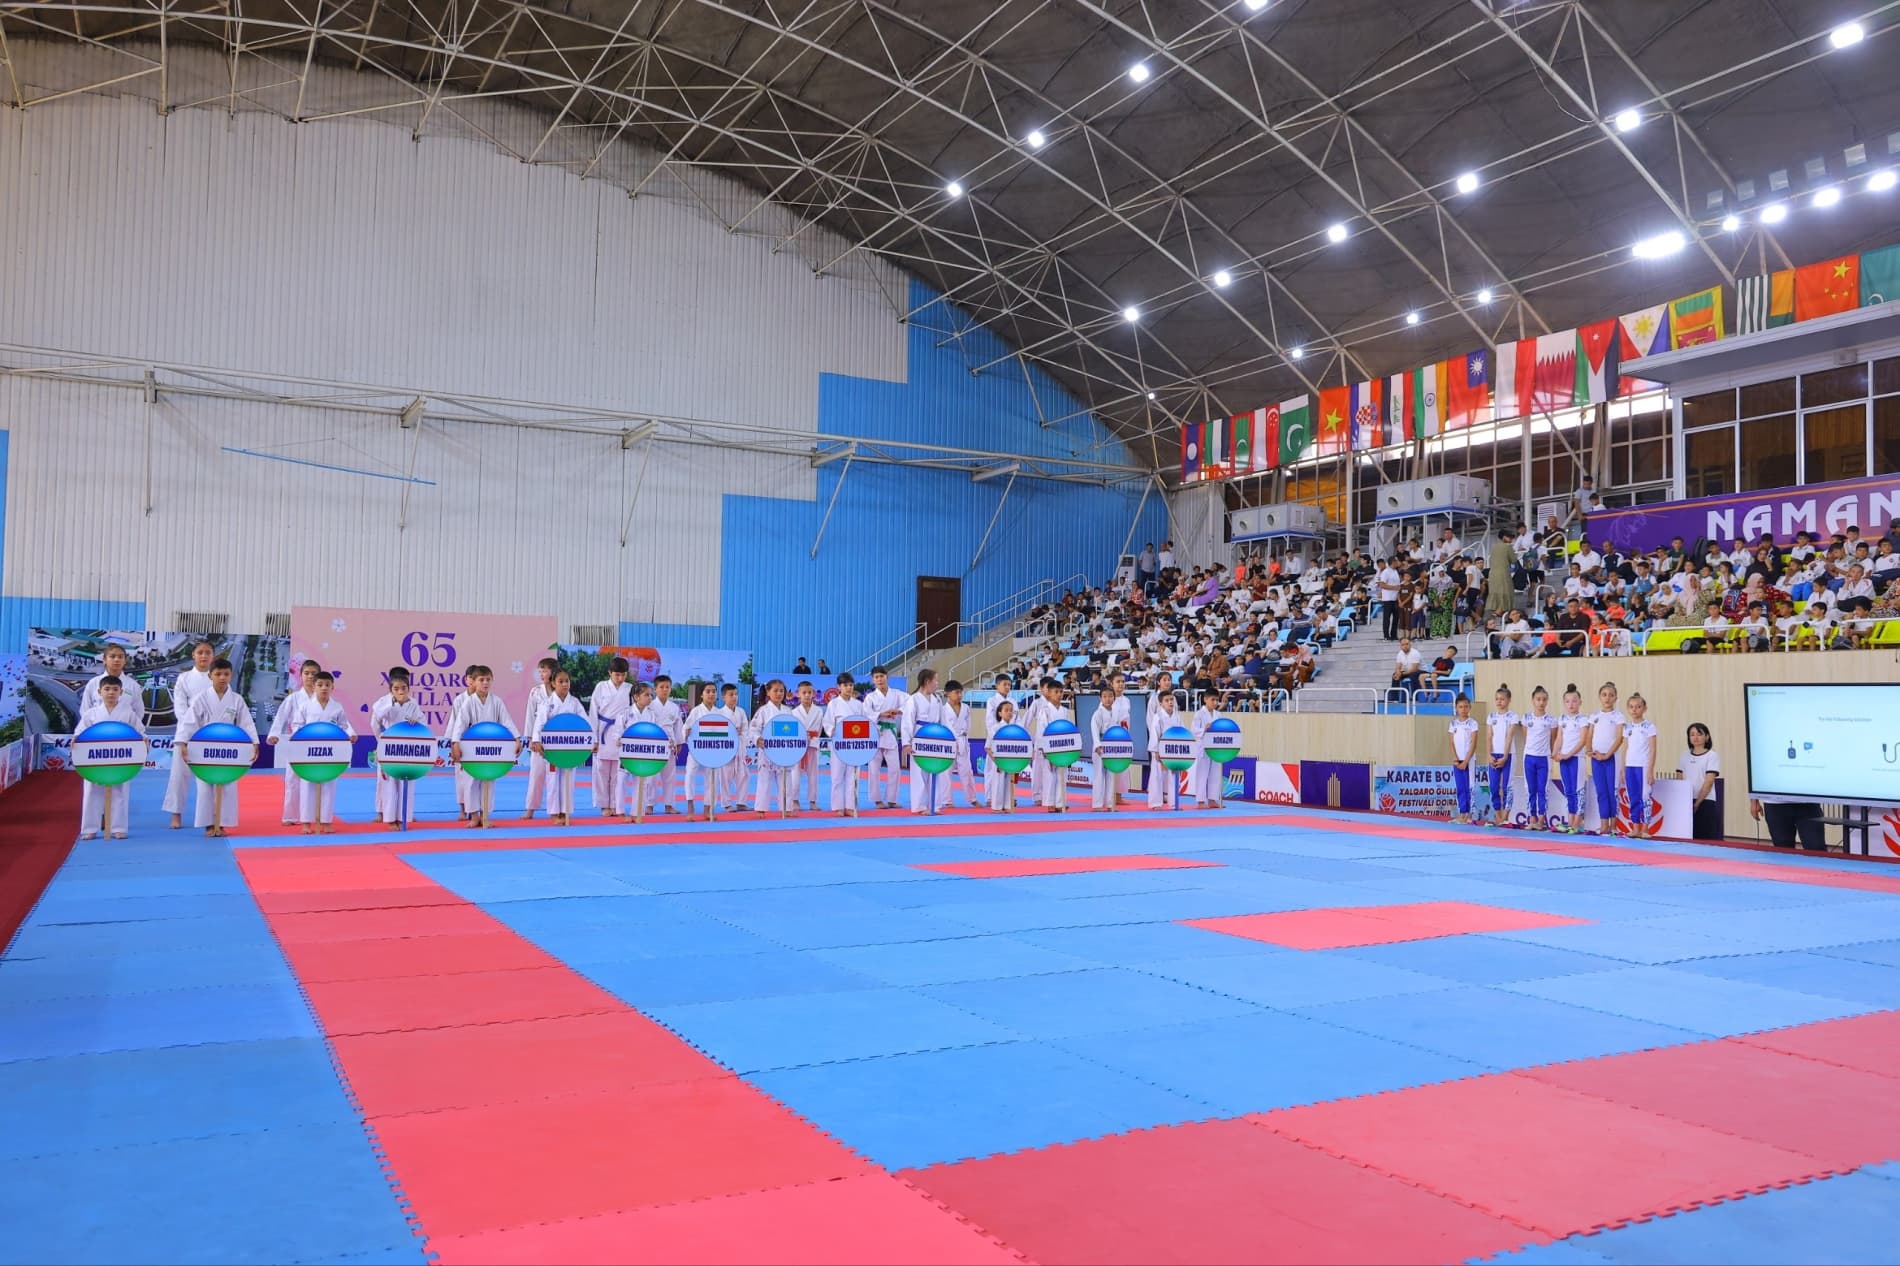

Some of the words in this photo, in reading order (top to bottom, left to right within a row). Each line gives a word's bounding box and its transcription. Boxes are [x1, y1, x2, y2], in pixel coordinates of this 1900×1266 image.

[401, 631, 456, 668] 65
[380, 671, 469, 691] XLQAR
[541, 735, 592, 745] NAMANGAN-2
[693, 739, 735, 749] TOJIKISTON
[308, 746, 333, 757] JIZZAX
[385, 744, 431, 757] NAMANGAN
[475, 746, 502, 756] NAVOIY
[622, 743, 656, 754] TOSHKENT
[915, 742, 943, 753] TOSHKENT
[88, 748, 132, 759] ANDIJON
[203, 748, 238, 759] BUXORO
[1387, 770, 1431, 783] KARATE
[1259, 790, 1294, 803] COACH
[1398, 787, 1435, 796] XALQARO
[1436, 787, 1457, 795] GULLA
[1398, 799, 1434, 807] FESTIVALI
[1435, 799, 1457, 807] DOIRA
